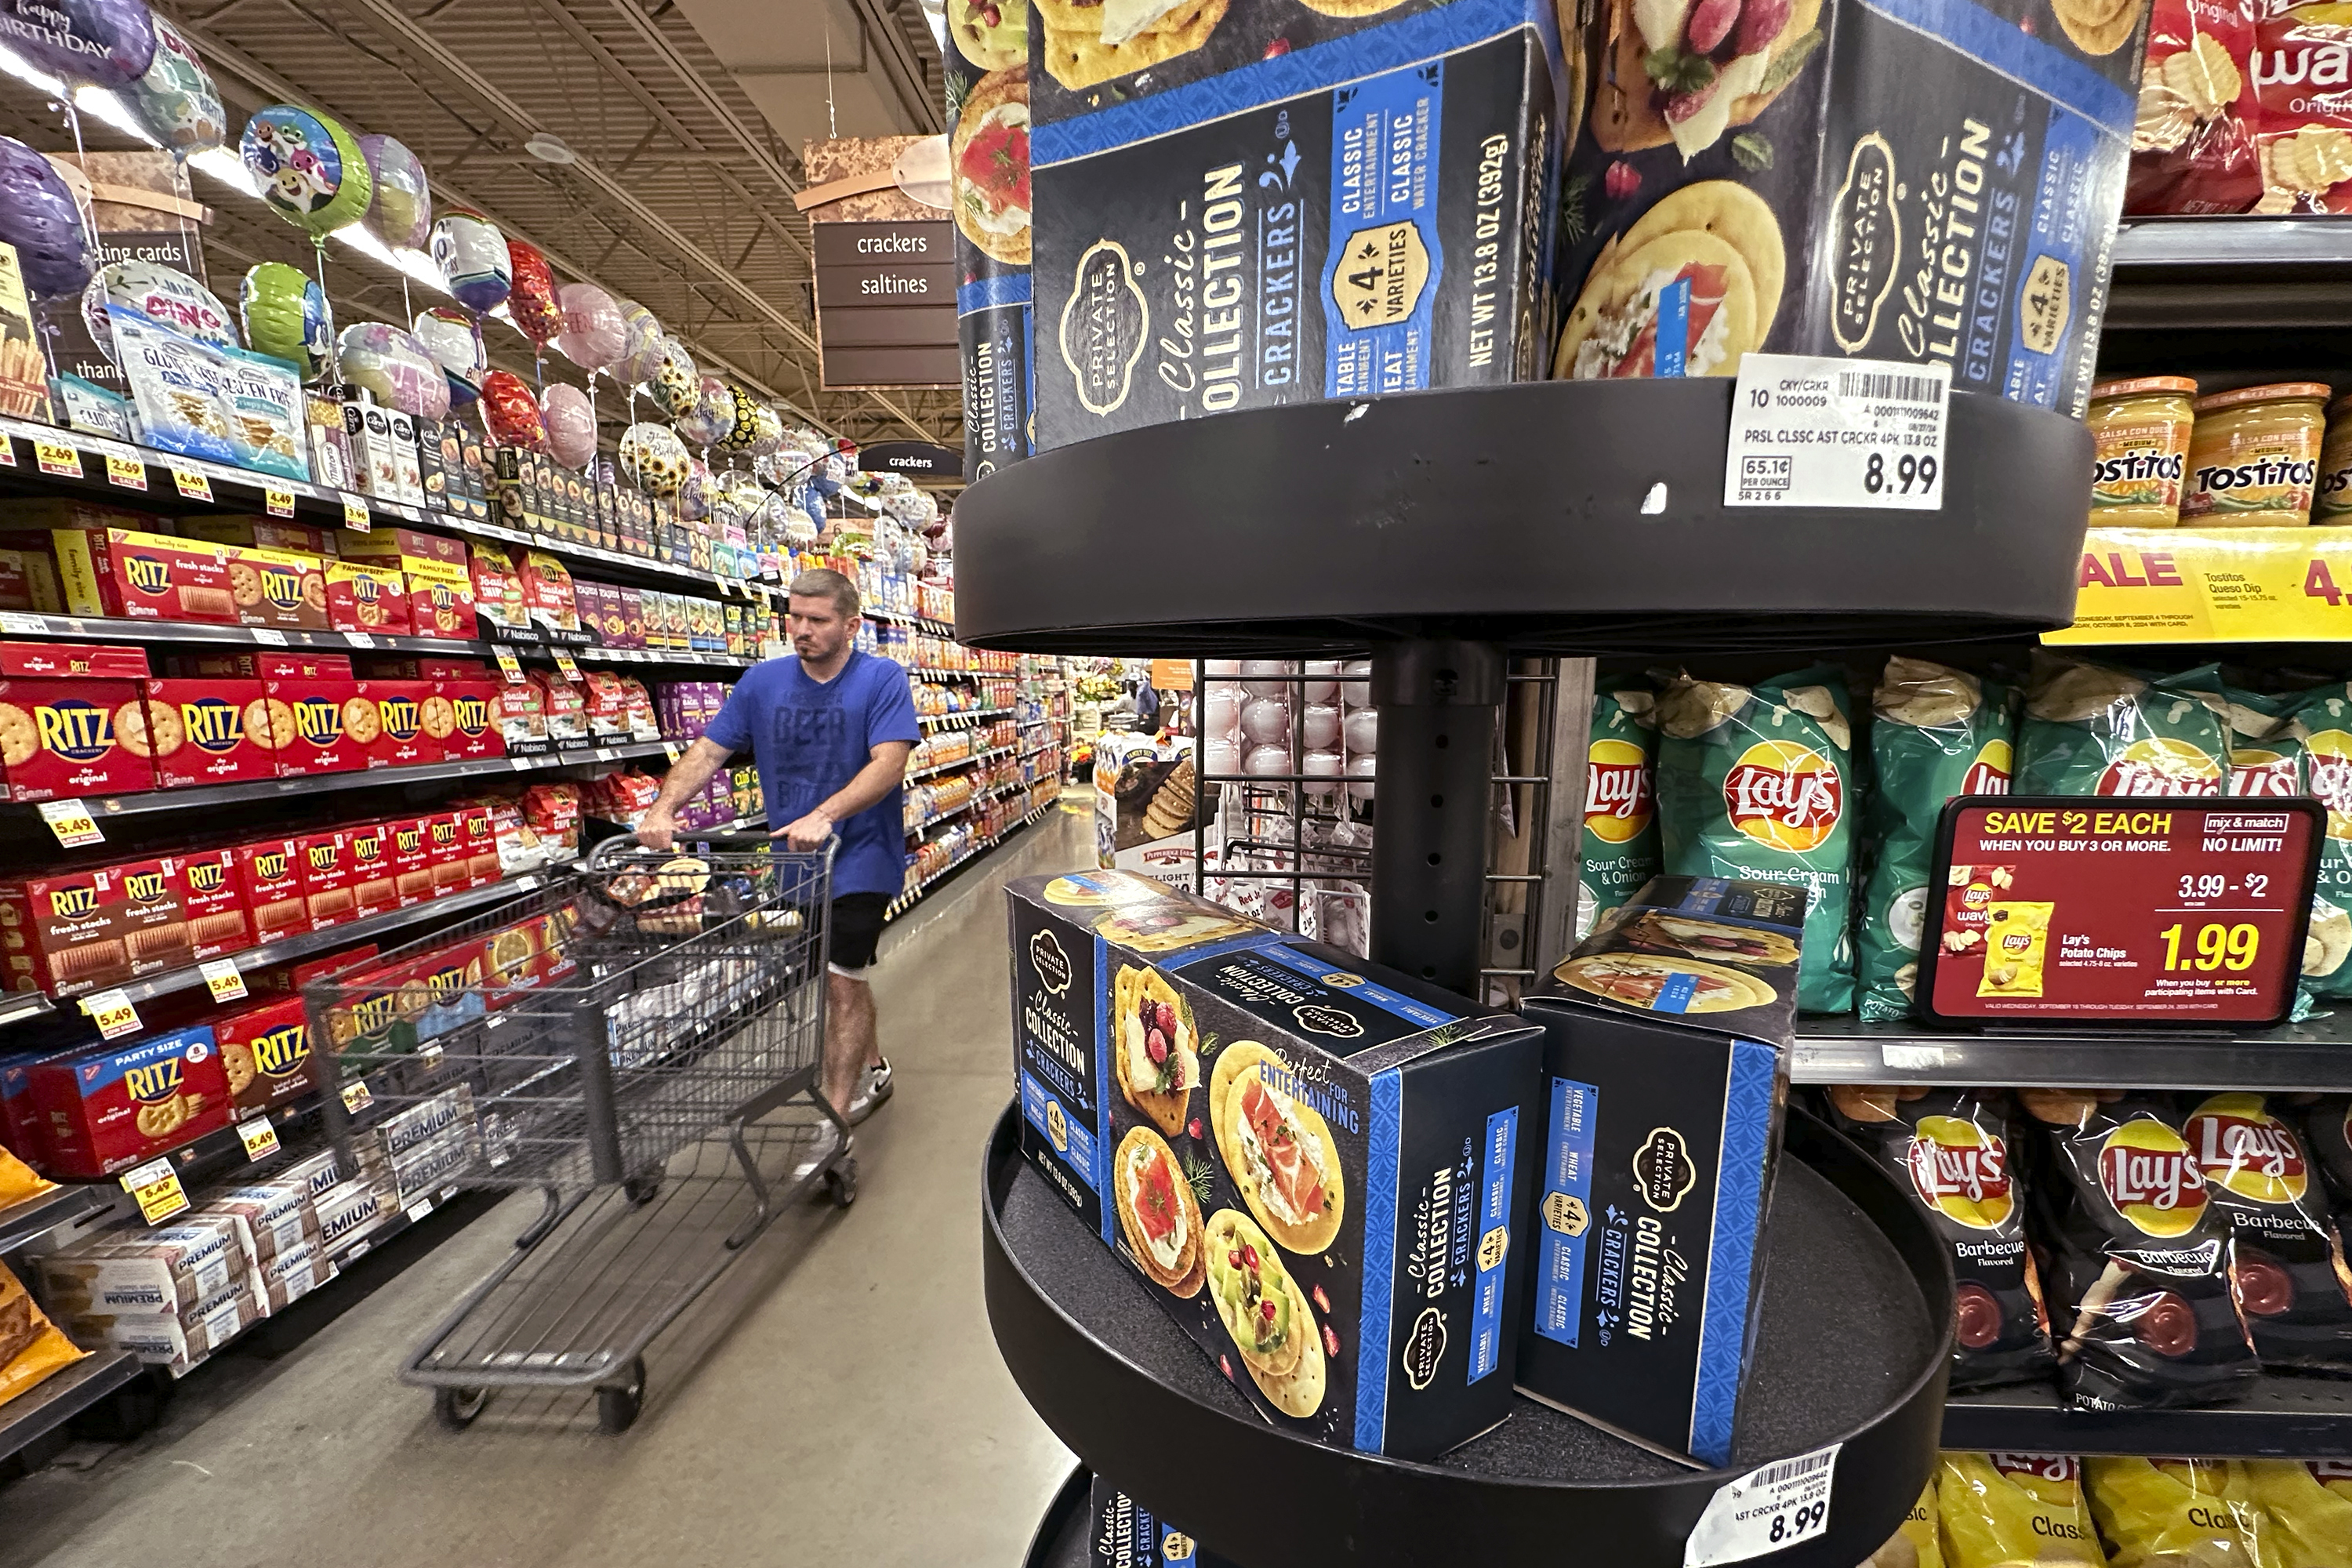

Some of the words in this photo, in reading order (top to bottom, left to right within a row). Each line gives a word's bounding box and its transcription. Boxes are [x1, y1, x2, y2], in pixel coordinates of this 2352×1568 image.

[1414, 97, 1430, 151] CRACKER
[1343, 127, 1363, 215] CLASSIC
[1363, 112, 1378, 219] ENTERTAINMENT
[1391, 114, 1413, 204] CLASSIC
[1478, 133, 1508, 208] (392g)
[1412, 155, 1425, 210] WATER
[857, 232, 927, 253] crackers
[1477, 212, 1500, 241] OZ
[1843, 169, 1872, 317] PRIVATE
[1929, 117, 1993, 368] LLECTION
[91, 243, 132, 262] eting
[137, 245, 181, 261] cards
[1853, 167, 1883, 326] SELECTION
[1349, 265, 1385, 289] 4
[1387, 229, 1409, 318] VARIETIES
[1473, 243, 1499, 296] 13.8
[1897, 169, 1948, 358] Classic
[861, 274, 928, 295] saltines
[1201, 162, 1246, 413] OLLECTION
[1262, 199, 1297, 387] CRACKERS
[1966, 188, 2016, 383] CRACKERS
[1105, 261, 1116, 391] SELECTION
[1158, 227, 1198, 394] Classic
[1472, 297, 1493, 325] WT
[1091, 271, 1104, 389] PRIVATE
[1469, 330, 1492, 369] NET
[967, 368, 981, 434] Classic
[978, 342, 996, 453] COLLECTION
[1000, 359, 1014, 430] CRACKERS
[1750, 389, 1769, 408] 10
[1780, 379, 1828, 393] CKY/CRKR
[1777, 395, 1827, 407] 1000009
[1744, 430, 1773, 444] PRSL
[1777, 430, 1813, 444] CLSSC
[1817, 430, 1838, 444] AST
[1841, 432, 1876, 445] CRCKR
[1880, 434, 1900, 446] 4PK
[1903, 434, 1920, 446] 13.8
[1923, 435, 1937, 448] OZ
[2100, 428, 2128, 437] SALSA
[2129, 427, 2147, 436] CON
[42, 446, 72, 460] 2.69
[112, 459, 139, 474] 2.69
[888, 456, 933, 468] crackers
[1746, 459, 1788, 475] 65.1¢
[180, 473, 203, 486] 4.49
[1743, 477, 1758, 486] PER
[1760, 477, 1788, 487] OUNCE
[1864, 452, 1937, 494] 8.99
[270, 493, 291, 504] 4.49
[123, 557, 172, 588] RITZ
[260, 569, 304, 602] RITZ
[2079, 552, 2183, 588] ALE
[2204, 572, 2245, 583] Tostitos
[352, 577, 381, 601] RITZ
[432, 584, 455, 606] RITZ
[2209, 583, 2241, 594] Queso
[2244, 583, 2262, 595] Dip
[34, 706, 117, 752] RITZ
[180, 704, 245, 744] RITZ
[293, 702, 344, 737] RITZ
[379, 701, 422, 734] RITZ
[453, 700, 489, 729] RITZ
[69, 771, 107, 786] original
[207, 762, 238, 775] original
[1736, 768, 1834, 829] Lay's
[55, 818, 91, 834] 5.49
[1984, 812, 2056, 834] SAVE
[2062, 811, 2088, 834] $2
[2094, 813, 2172, 834] EACH
[2208, 816, 2231, 834] mix
[2233, 817, 2243, 828] &
[2245, 817, 2283, 829] match
[1146, 849, 1178, 860] PEPPERIDGE
[1980, 840, 2023, 851] WHEN
[2025, 840, 2056, 851] YOU
[2058, 840, 2089, 851] BUY
[2089, 840, 2098, 851] 3
[2101, 840, 2122, 851] OR
[2125, 840, 2172, 852] MORE.
[2202, 838, 2228, 851] NO
[2230, 838, 2282, 852] LIMIT!
[187, 863, 226, 888] RITZ
[255, 853, 289, 877] RITZ
[1586, 858, 1616, 873] Sour
[1601, 873, 1610, 885] &
[1613, 871, 1646, 884] Onion
[1739, 866, 1783, 880] Sour
[50, 887, 100, 916] RITZ
[124, 873, 167, 900] RITZ
[1238, 895, 1254, 906] Red
[2178, 874, 2224, 898] 3.99
[2245, 873, 2268, 898] $2
[2060, 947, 2094, 958] Potato
[2096, 947, 2126, 959] Chips
[2062, 935, 2089, 945] Lay's
[2160, 923, 2259, 971] 1.99
[1034, 953, 1066, 981] SELECTION
[1036, 944, 1066, 971] PRIVATE
[212, 976, 239, 990] 5.49
[1219, 964, 1305, 1007] COLLECTION
[2145, 988, 2194, 997] participating
[100, 1008, 132, 1025] 5.49
[1034, 990, 1072, 1036] Classic
[115, 1047, 155, 1066] PARTY
[157, 1039, 183, 1054] SIZE
[1024, 1006, 1085, 1076] COLLECTION
[1275, 1047, 1332, 1086] Perfect
[1259, 1059, 1359, 1135] ENTERTAINING
[1329, 1082, 1348, 1102] FOR
[1570, 1090, 1584, 1132] VEGETABLE
[248, 1131, 273, 1149] 5.49
[392, 1106, 457, 1150] PREMIUM
[2200, 1116, 2296, 1178] Lay's
[1567, 1152, 1579, 1181] WHEAT
[1653, 1138, 1664, 1200] SELECTION
[1662, 1142, 1675, 1199] PRIVATE
[1922, 1142, 2005, 1202] Lay's
[2115, 1149, 2203, 1212] Lay's
[258, 1195, 307, 1228] PREMIUM
[321, 1198, 379, 1240] EMIUM
[1454, 1181, 1471, 1265] CRACKERS
[1552, 1195, 1563, 1230] VARIETIES
[2234, 1211, 2321, 1230] Barbecue
[1407, 1199, 1430, 1276] Classic
[1426, 1167, 1452, 1299] COLLECTION
[1494, 1227, 1503, 1265] VARIETIES
[1956, 1240, 2025, 1258] Barbecue
[2263, 1230, 2307, 1240] Flavored
[179, 1233, 232, 1272] PREMIUM
[270, 1244, 318, 1279] PREMIUM
[1601, 1229, 1622, 1308] CRACKERS
[1977, 1257, 2015, 1268] Flavored
[2140, 1249, 2214, 1265] Barbecue
[1628, 1216, 1662, 1341] COLLECTION
[1657, 1248, 1689, 1324] Classic
[189, 1283, 244, 1323] PREMIUM
[1482, 1284, 1492, 1315] WHEAT
[1418, 1323, 1428, 1378] PRIVATE
[1425, 1317, 1434, 1377] SELECTION
[1752, 1503, 1780, 1518] CRCKR
[1782, 1497, 1798, 1510] 4PK
[1799, 1492, 1814, 1504] 13.8
[1769, 1501, 1825, 1543] 8.99
